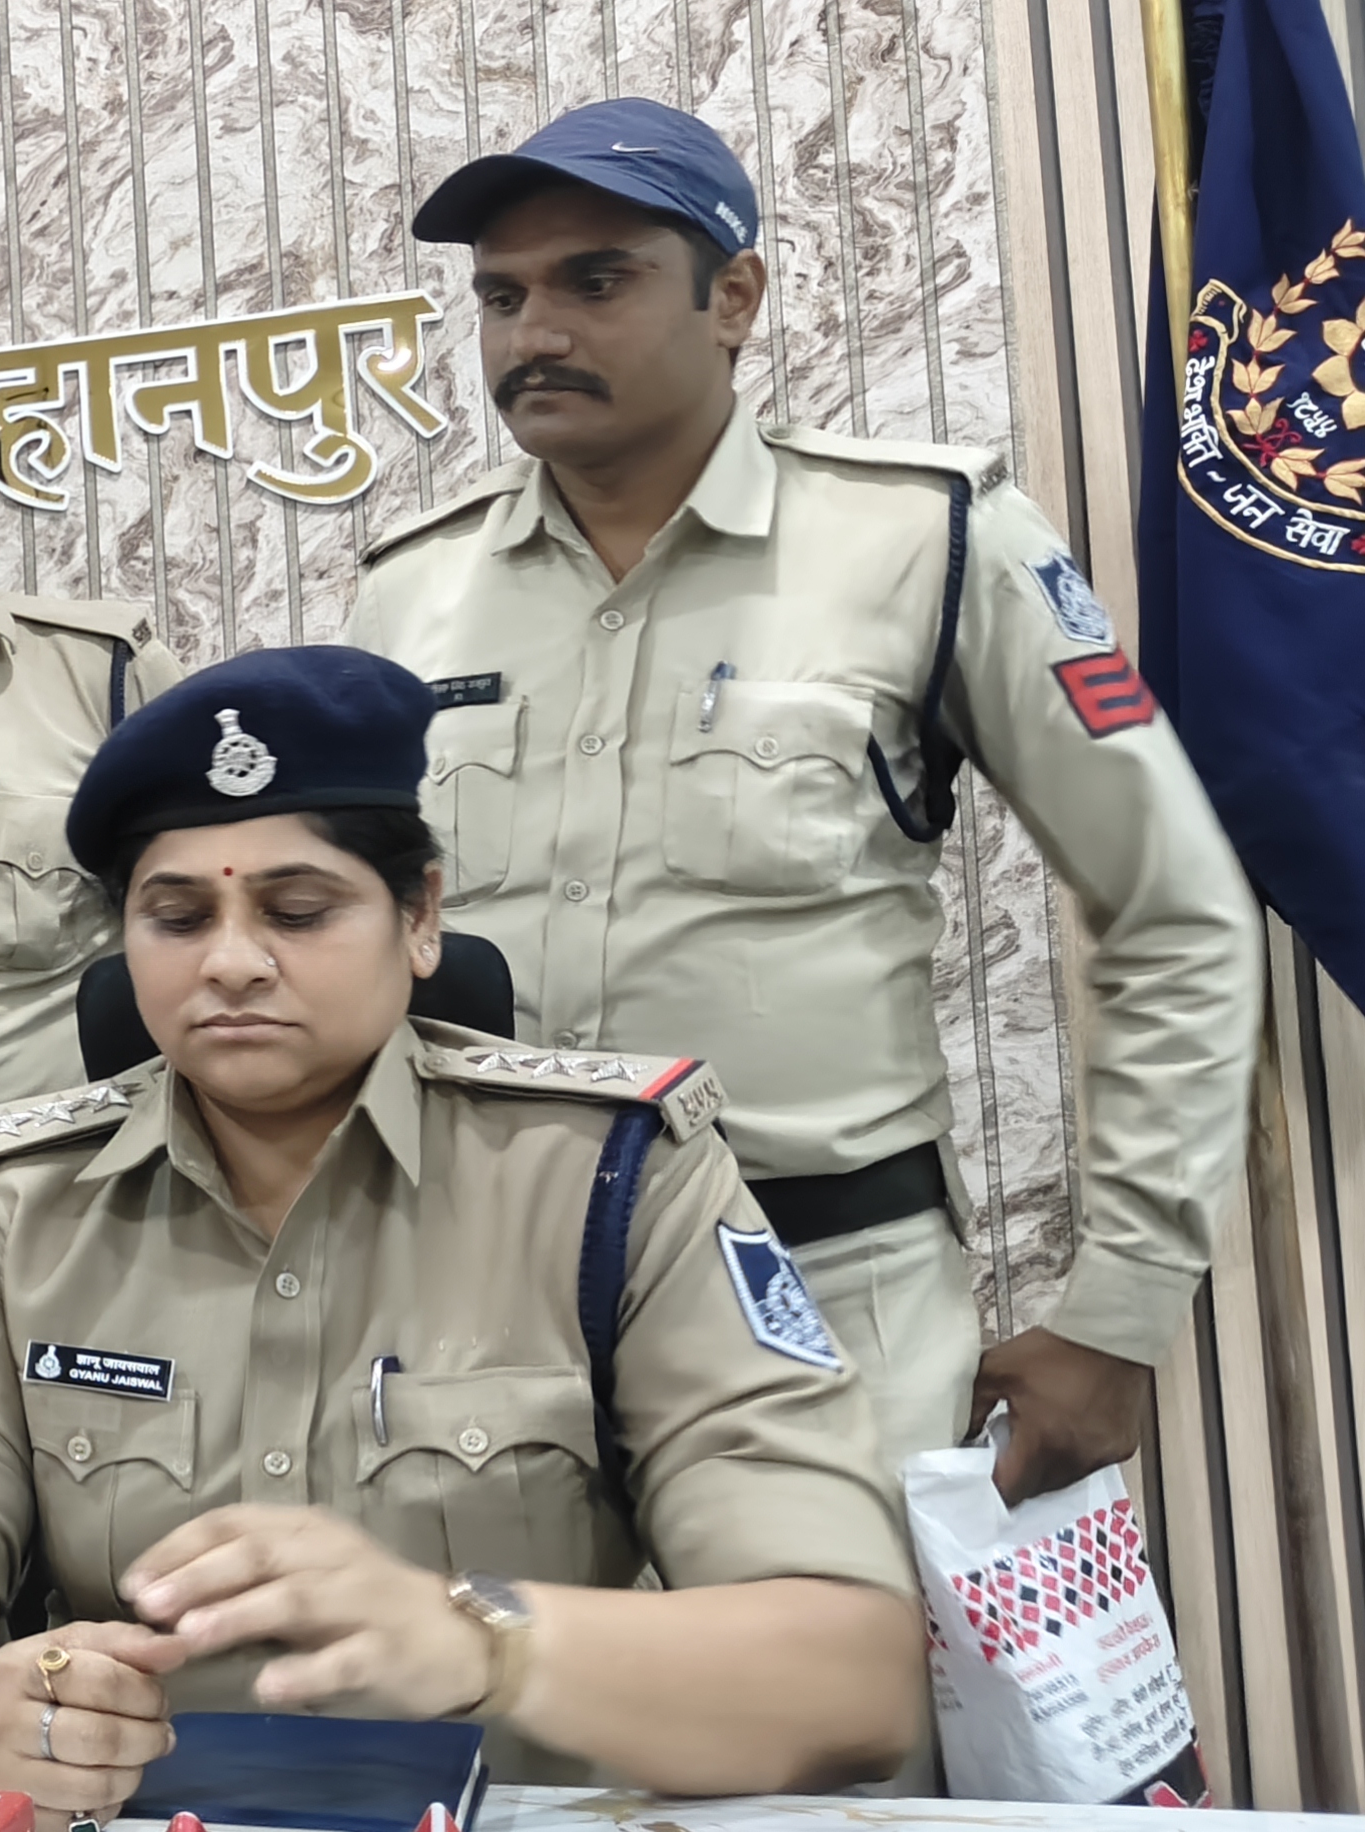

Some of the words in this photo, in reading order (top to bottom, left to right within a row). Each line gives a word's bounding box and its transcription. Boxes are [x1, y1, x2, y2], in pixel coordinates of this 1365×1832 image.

[1285, 507, 1351, 556] सेवा
[102, 1357, 161, 1376] जायसवाल
[68, 1368, 111, 1383] GYANU
[111, 1373, 163, 1391] JAISWAL
